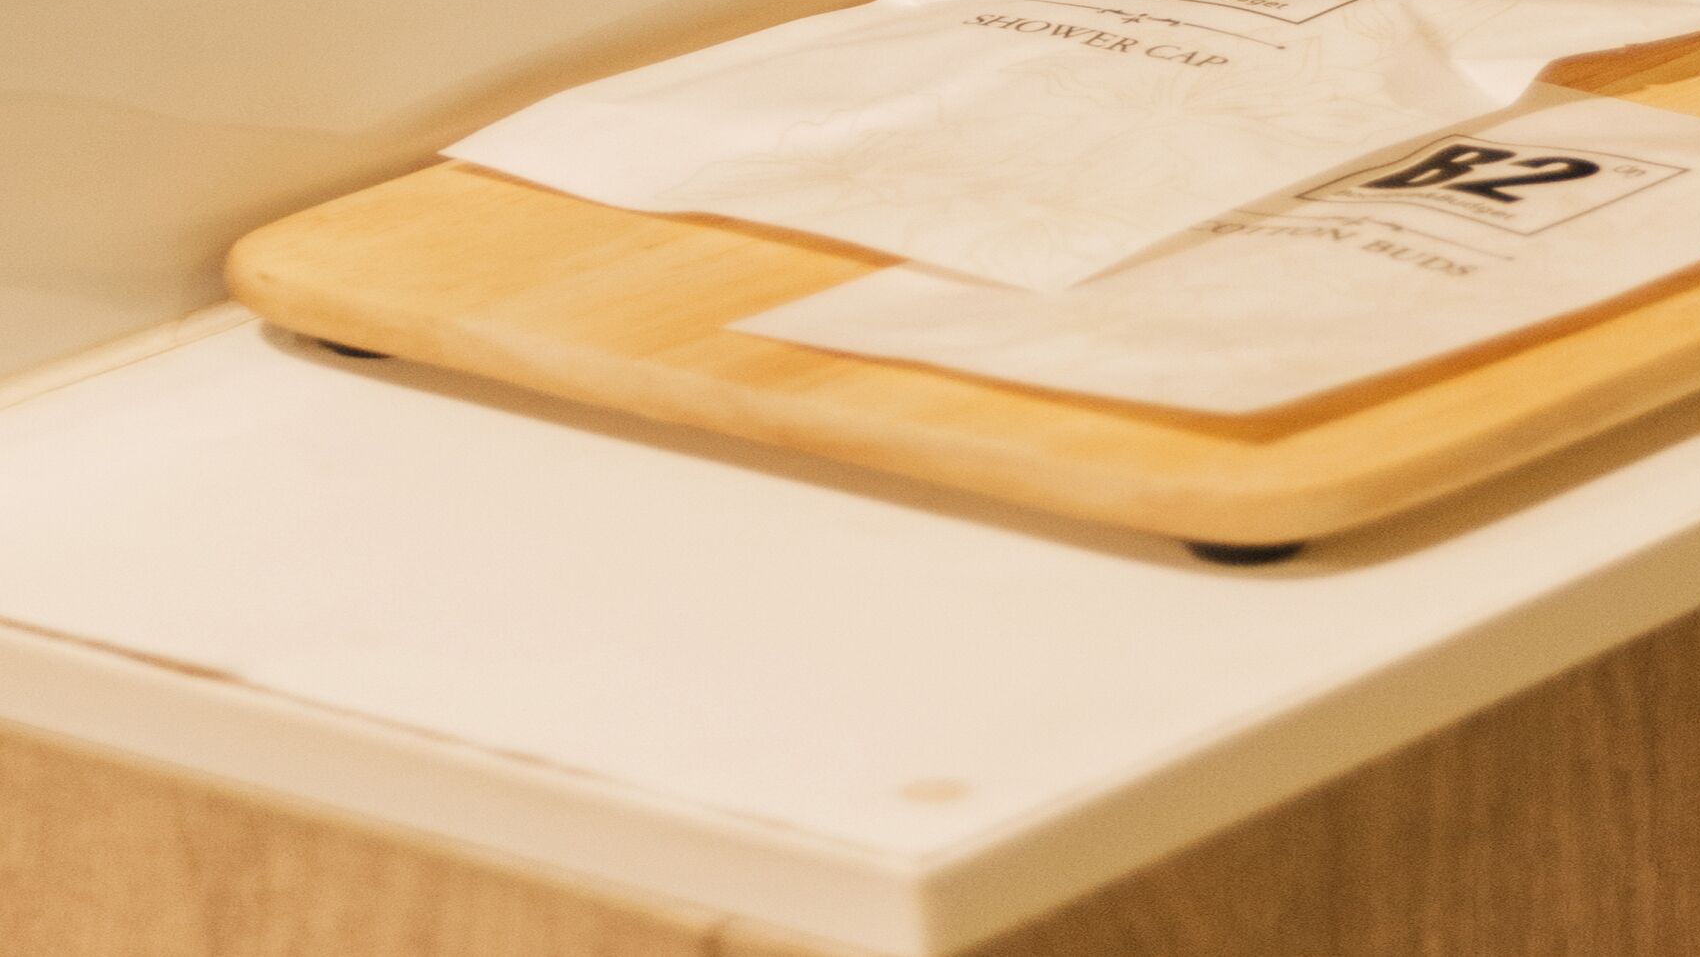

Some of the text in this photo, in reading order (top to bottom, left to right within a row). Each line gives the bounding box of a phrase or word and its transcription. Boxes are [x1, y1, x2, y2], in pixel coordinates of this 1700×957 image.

[963, 14, 1229, 67] SHOWER CAP
[1360, 143, 1601, 203] B2
[1206, 222, 1479, 276] OTTON BUDS
